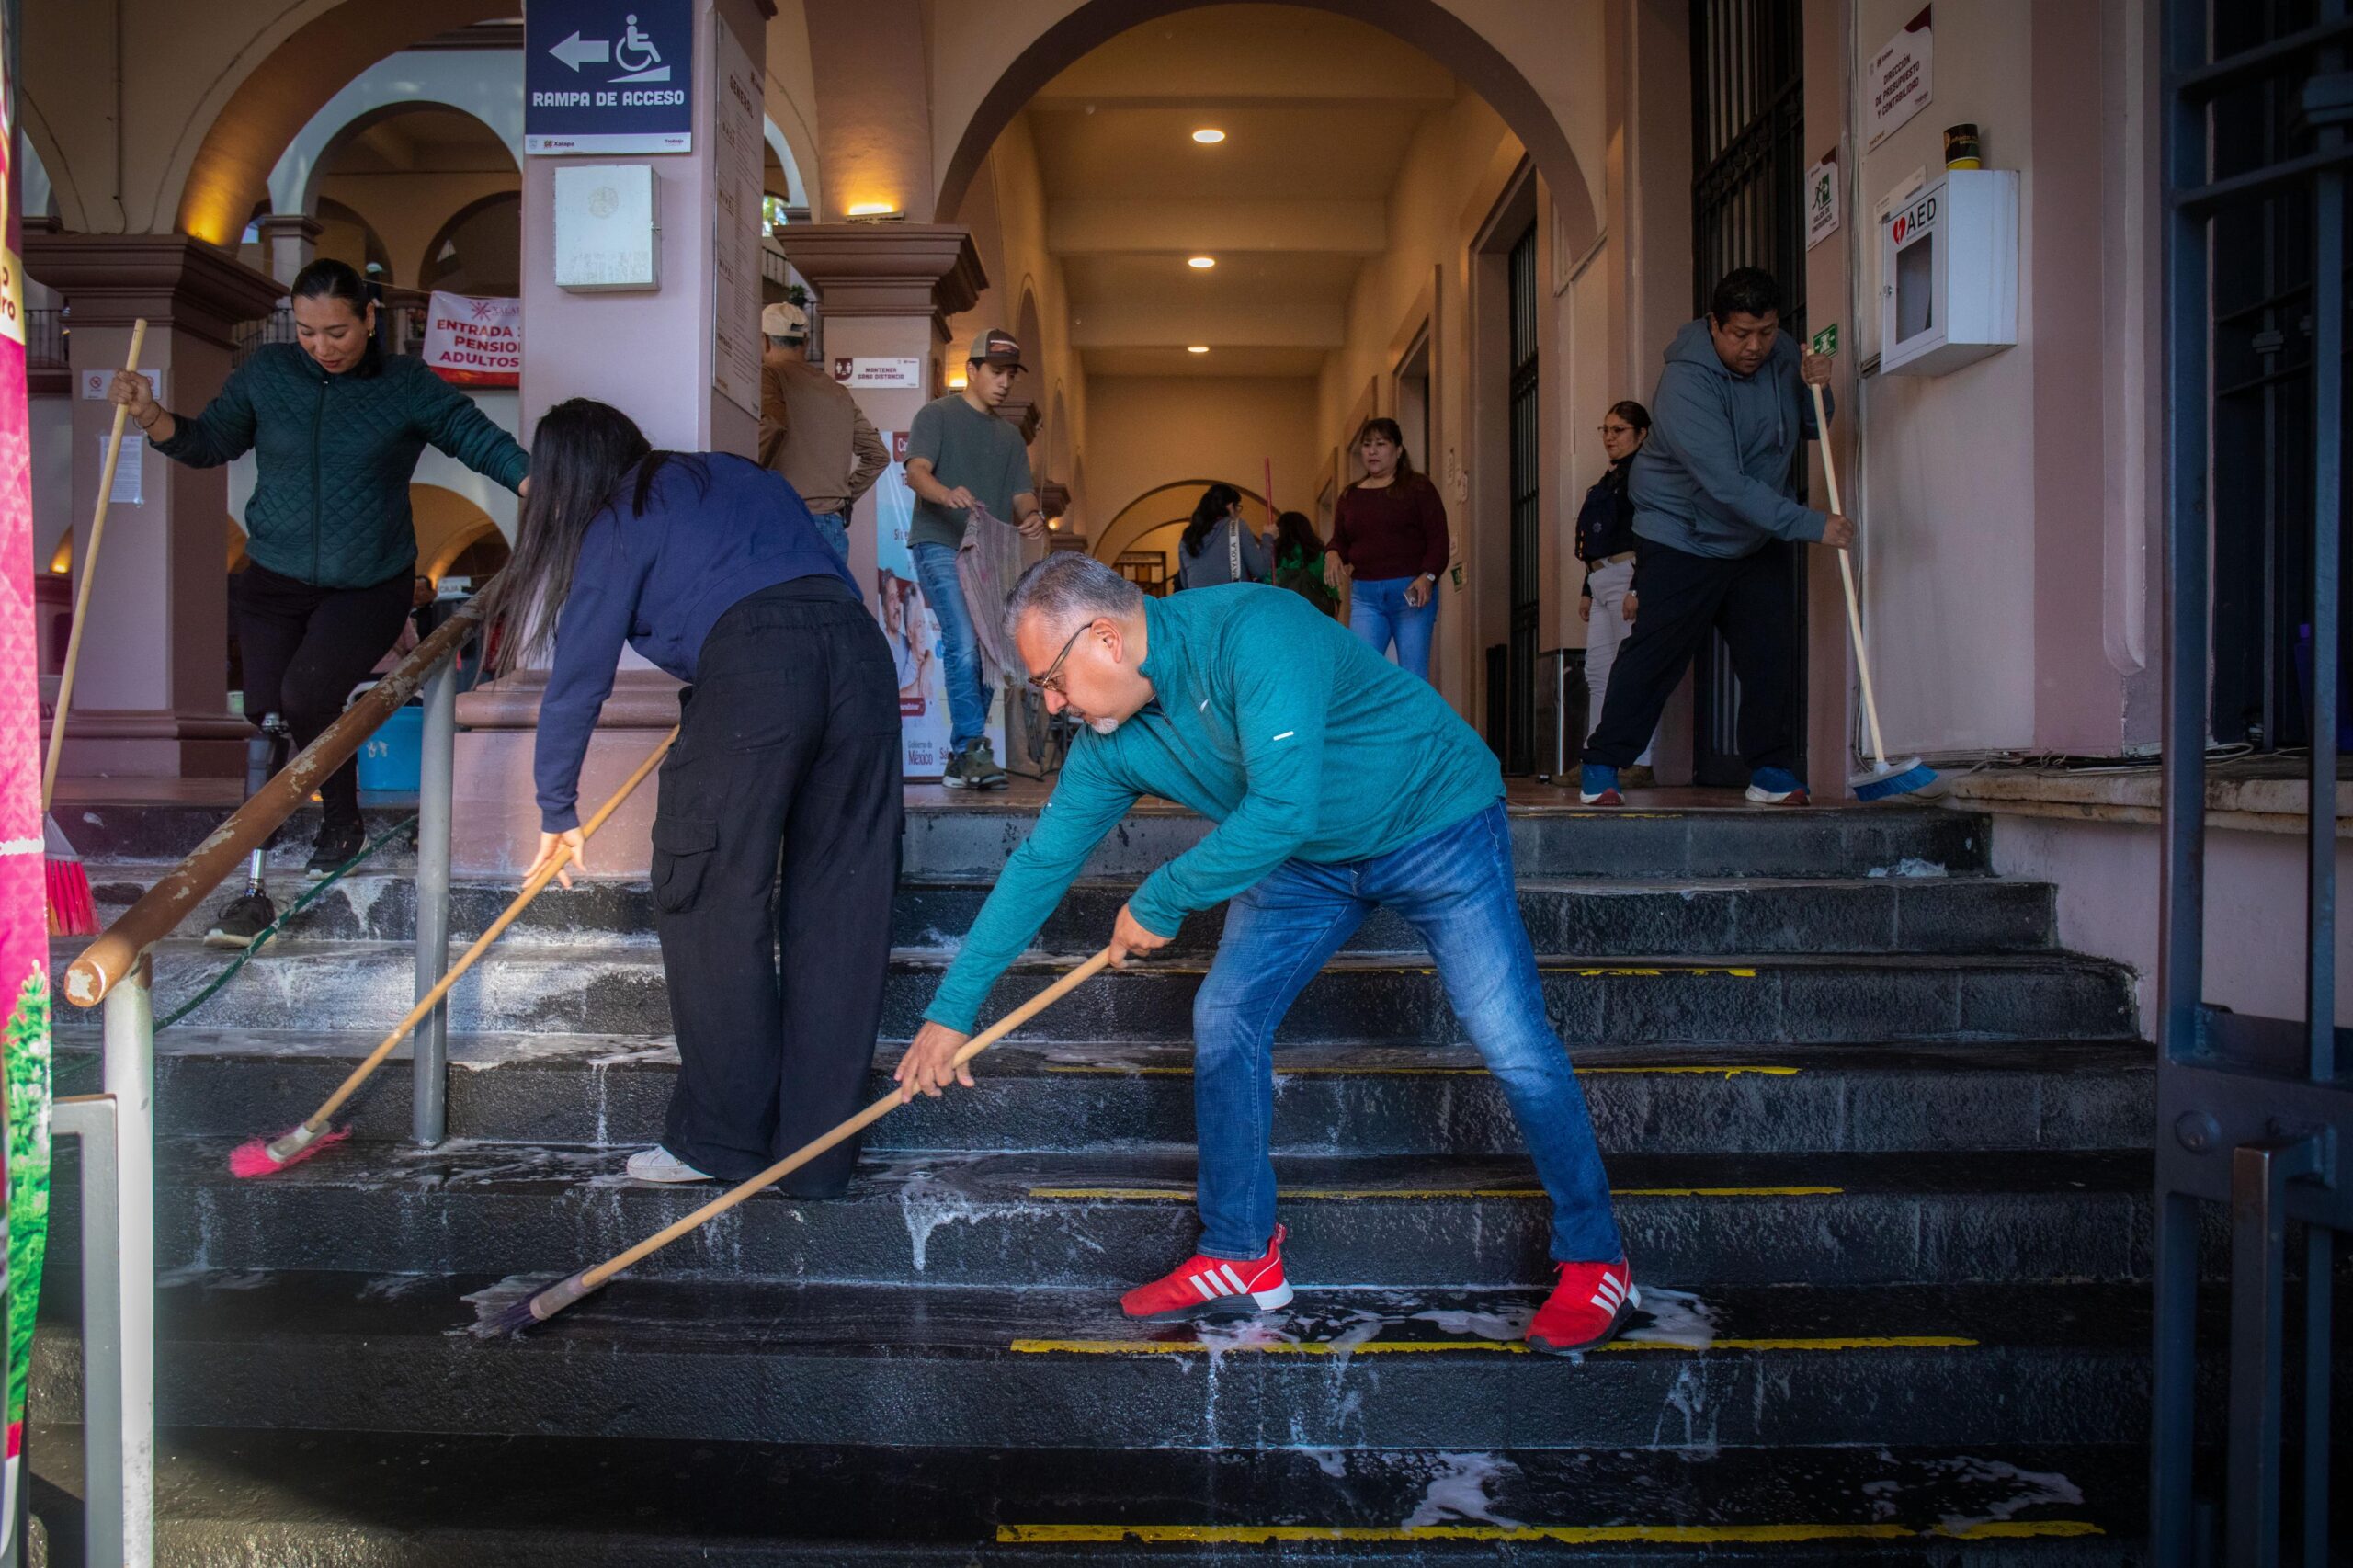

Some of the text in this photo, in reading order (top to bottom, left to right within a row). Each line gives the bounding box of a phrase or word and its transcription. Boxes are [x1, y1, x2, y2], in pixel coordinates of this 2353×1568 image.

[1883, 61, 1920, 101] PRESUPUESTO
[532, 90, 685, 107] RAMPA DE ACCESO
[1906, 197, 1937, 235] AED
[437, 319, 513, 337] ENTRADA
[455, 335, 520, 353] PENSIO
[439, 351, 519, 368] ADULTOS
[908, 749, 933, 766] México
